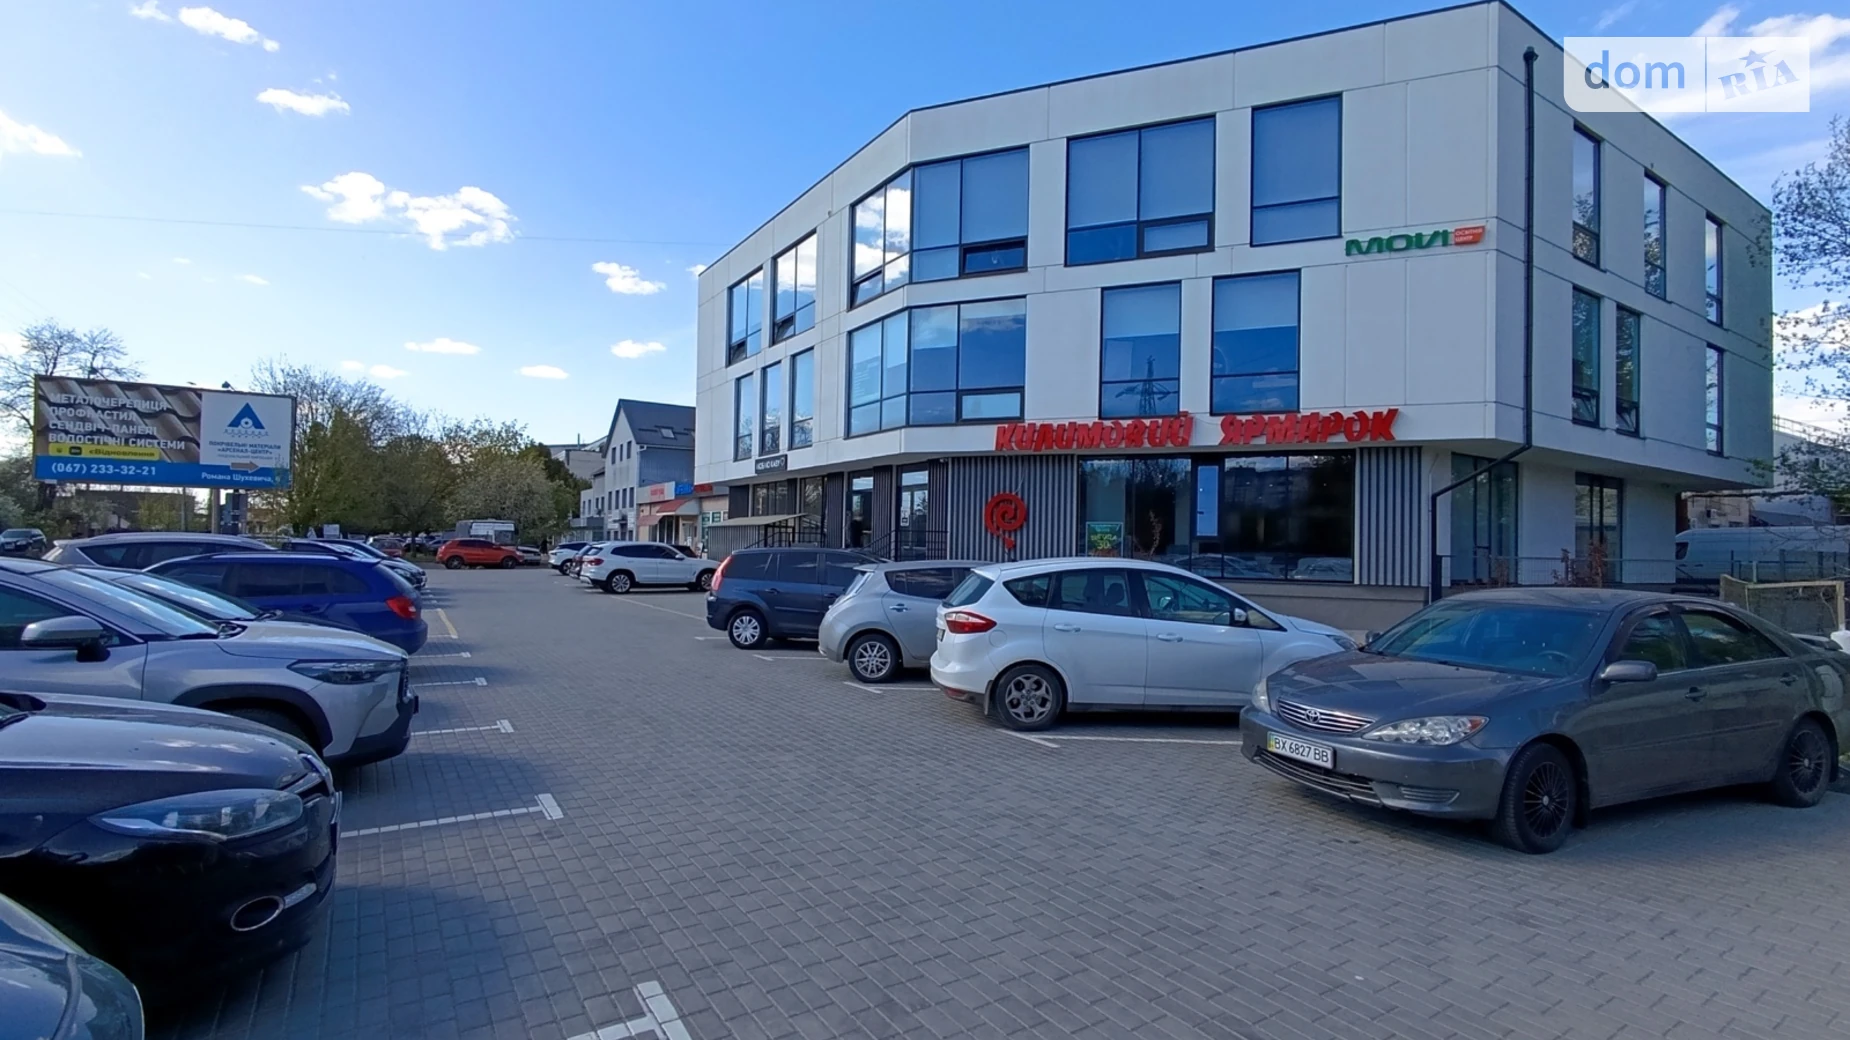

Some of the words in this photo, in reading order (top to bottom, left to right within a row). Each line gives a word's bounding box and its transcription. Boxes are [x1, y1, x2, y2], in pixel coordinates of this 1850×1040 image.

[50, 393, 168, 411] МЕТАЛОЧЕРЕПИЦЯ
[49, 420, 157, 436] СЕНДВІЧ-ПАНЕЛІ
[995, 411, 1195, 452] КИЛИМОВИЙ
[1219, 408, 1399, 446] ЯРМАРОК
[49, 433, 126, 446] ВОДОСТІЧНІ
[128, 438, 185, 450] СИСТЕМИ
[51, 462, 87, 475] (067)
[90, 463, 156, 476] 233-32-21
[201, 472, 231, 481] Романа
[1274, 737, 1287, 752] BX
[1288, 742, 1312, 758] 6827
[1313, 747, 1329, 763] BB
